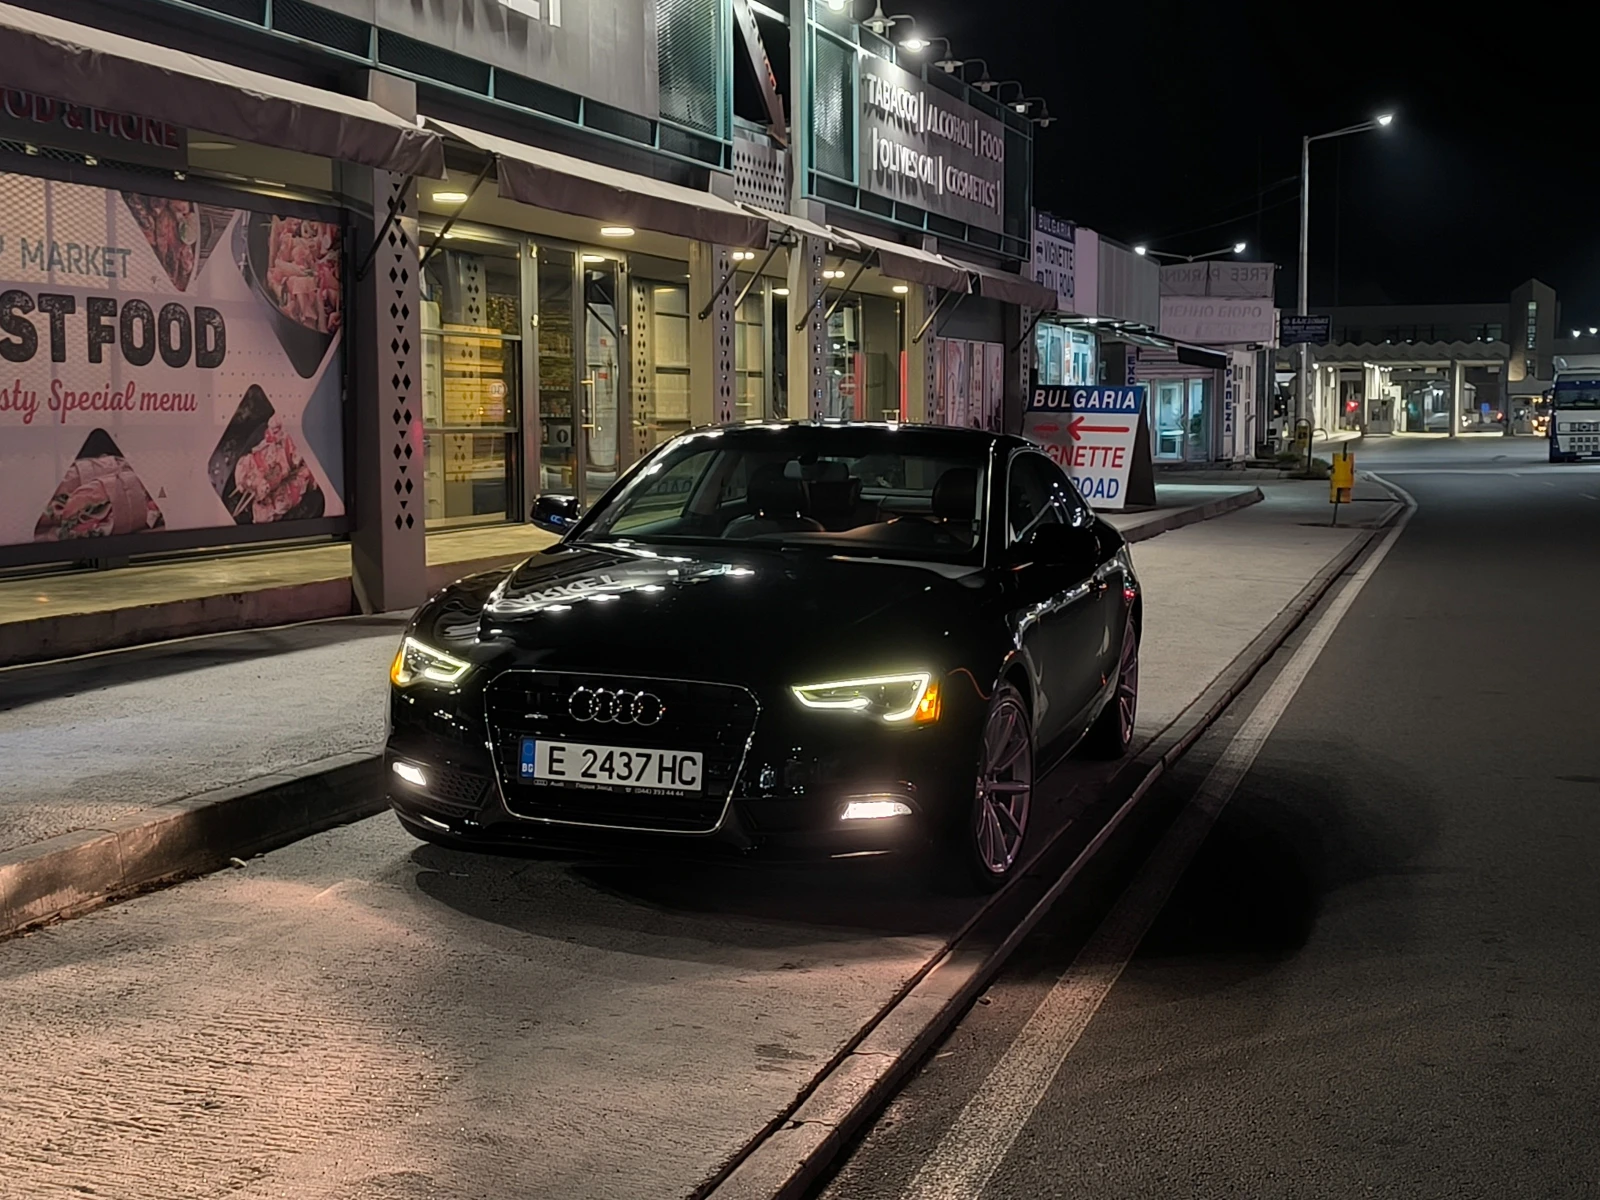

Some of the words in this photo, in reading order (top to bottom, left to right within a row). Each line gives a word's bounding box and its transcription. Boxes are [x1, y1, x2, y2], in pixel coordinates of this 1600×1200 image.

[866, 73, 918, 124] TABACCO
[927, 104, 972, 150] ALCOHOL
[980, 130, 1004, 163] FOOD
[880, 138, 918, 179] OLIVES
[946, 165, 995, 208] COSMETICS
[1038, 214, 1072, 240] BULGARIA
[21, 238, 131, 279] MARKET
[1044, 240, 1073, 271] VIGNETTE
[0, 289, 76, 362] ST
[86, 297, 226, 368] FOOD
[1218, 306, 1262, 318] БЮРО
[48, 379, 136, 424] Special
[139, 391, 198, 413] menu
[1033, 389, 1135, 409] BULGARIA
[521, 762, 534, 773] BG
[548, 746, 565, 776] E
[581, 748, 652, 782] 2437
[657, 754, 697, 786] HC
